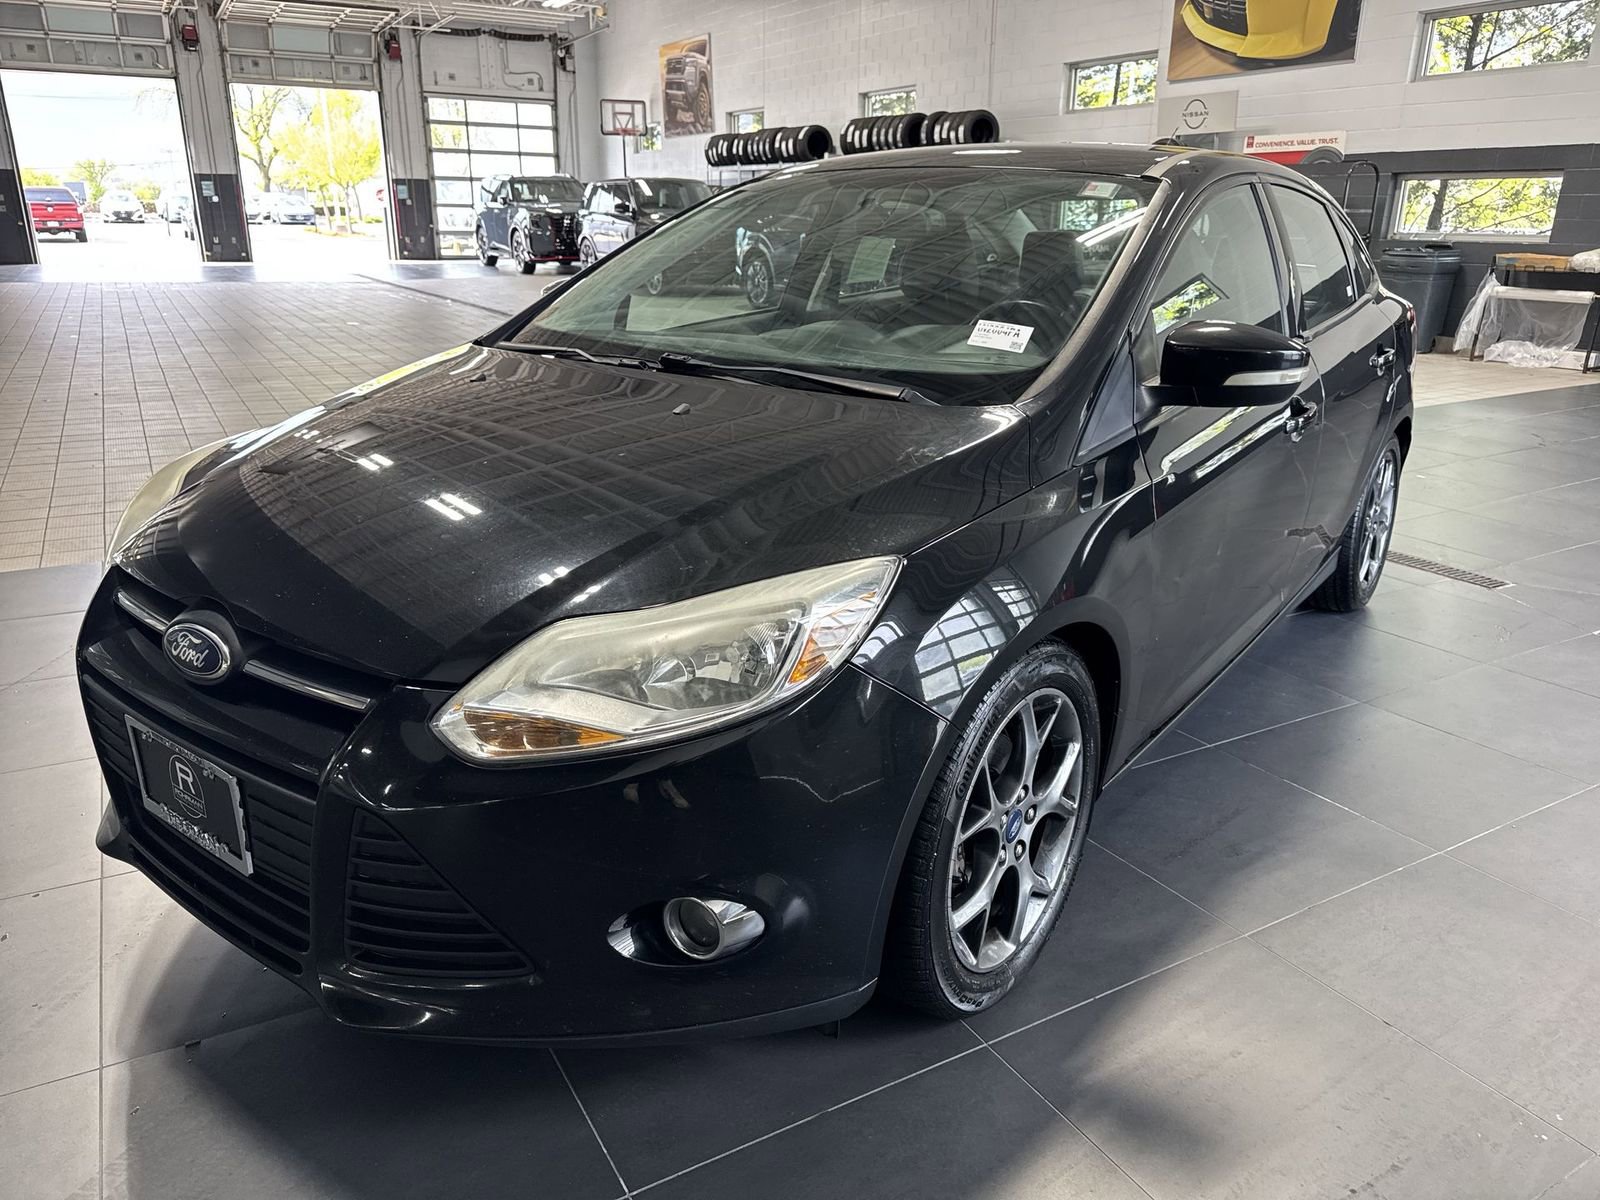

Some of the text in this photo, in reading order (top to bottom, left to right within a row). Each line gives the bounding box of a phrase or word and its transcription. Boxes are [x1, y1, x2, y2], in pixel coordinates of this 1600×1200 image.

[1182, 110, 1209, 118] NISSAN
[171, 631, 209, 668] Ford
[175, 761, 195, 795] R
